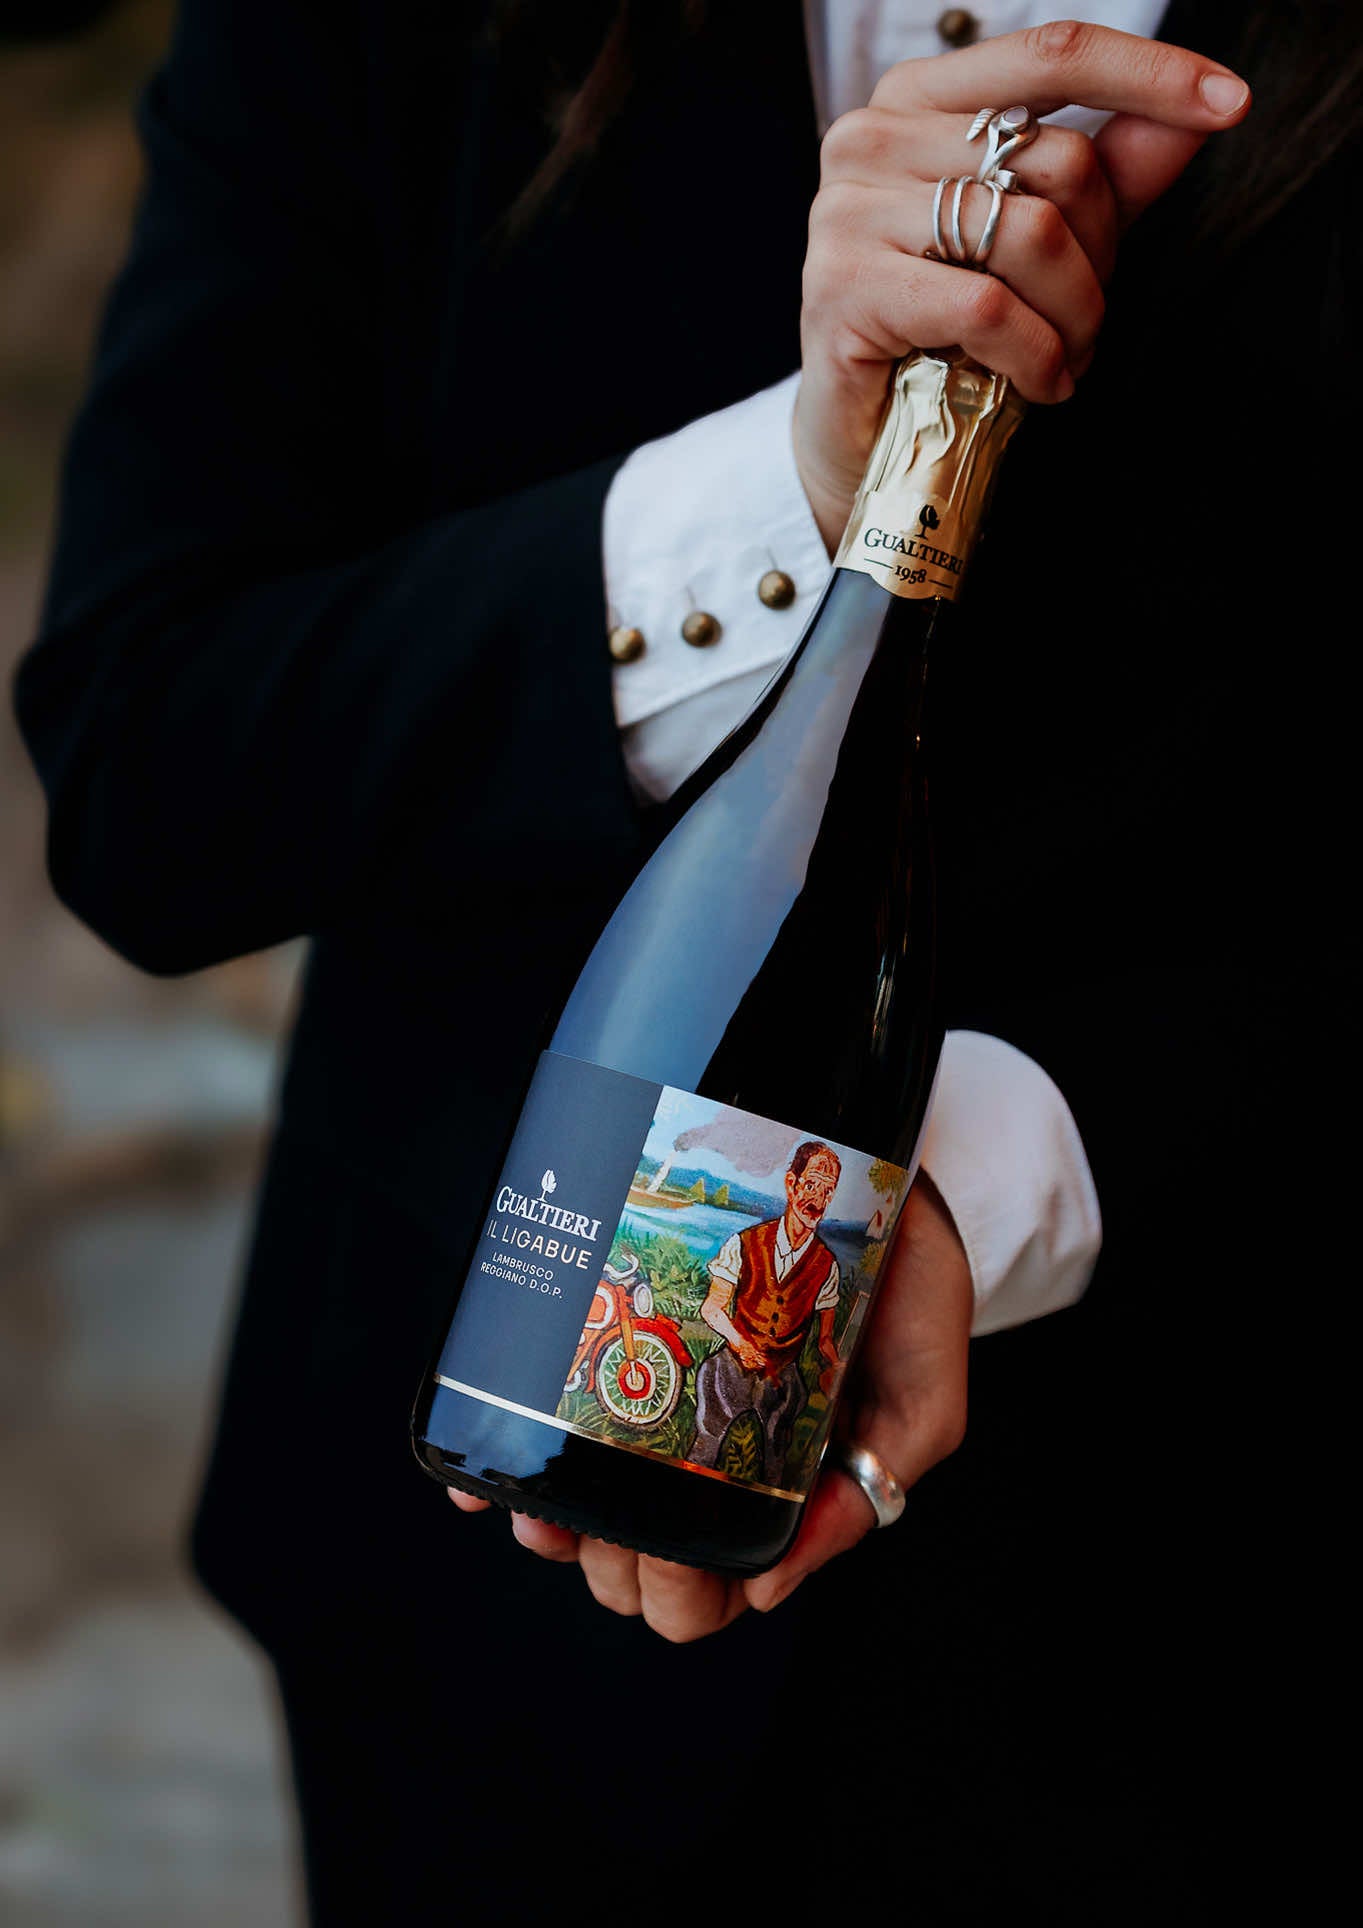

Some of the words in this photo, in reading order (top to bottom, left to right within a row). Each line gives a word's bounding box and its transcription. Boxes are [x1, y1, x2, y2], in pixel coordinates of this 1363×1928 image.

[895, 565, 927, 584] 1958
[496, 1186, 602, 1241] GUALTIERI
[486, 1219, 497, 1238] IL
[502, 1224, 592, 1270] LIGABUE
[480, 1262, 526, 1286] REGGIANO
[529, 1279, 563, 1299] D.O.P.
[492, 1252, 554, 1280] LAMBRUSCO
